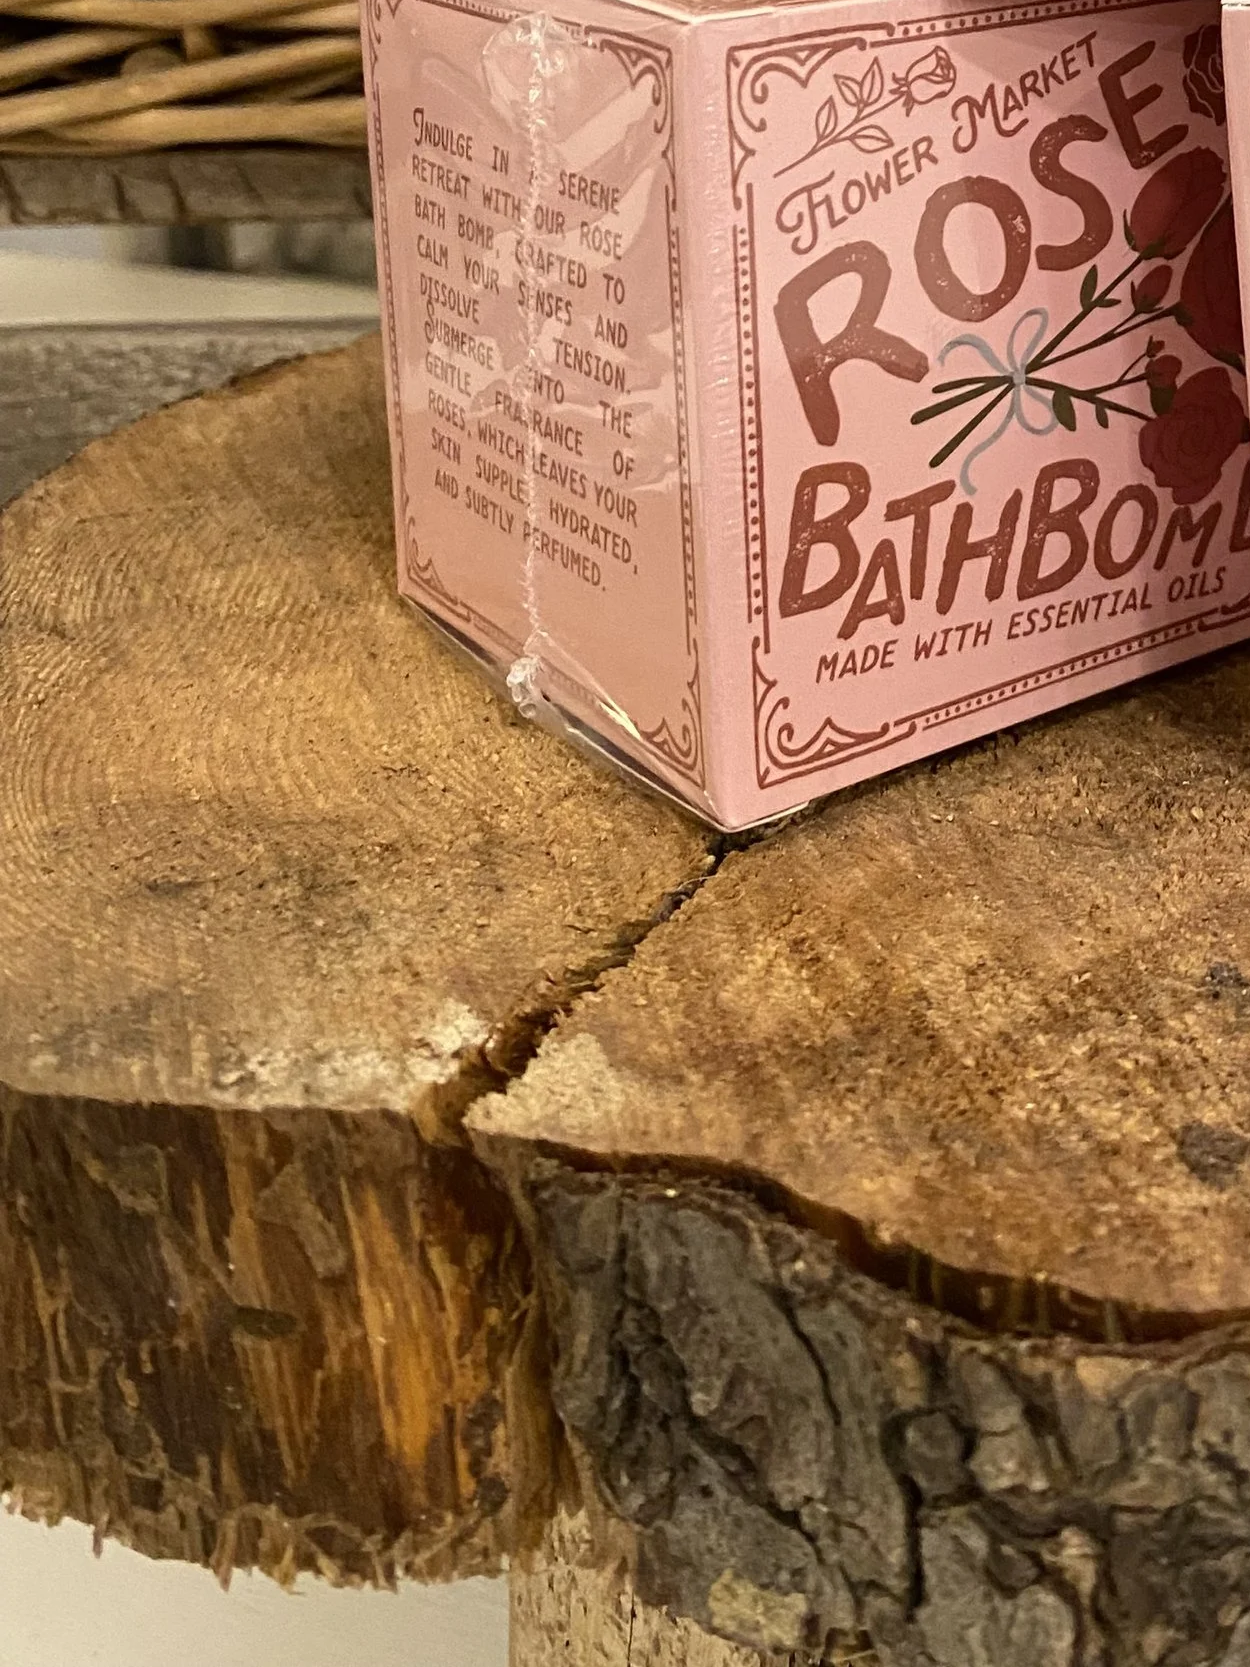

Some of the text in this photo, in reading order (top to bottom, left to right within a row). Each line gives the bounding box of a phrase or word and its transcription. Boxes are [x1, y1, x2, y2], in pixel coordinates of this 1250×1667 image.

[413, 107, 473, 162] INDULGE
[492, 145, 509, 176] IN
[558, 169, 620, 215] SERENE
[776, 30, 1098, 255] FLOWER MARKET
[412, 154, 623, 261] RETREAT WITH OUR ROSE
[415, 194, 625, 305] BATH BOMB, CRAFTED TO
[774, 39, 1190, 447] ROSE
[417, 234, 448, 270] CALM
[463, 255, 500, 295] YOUR
[594, 313, 628, 349] AND
[420, 273, 632, 396] DISSOLVE TENSION.
[424, 299, 633, 439] SUBMERGE NTO THE
[425, 351, 635, 480] GENTLE FRARANCE OF
[428, 388, 638, 528] ROSES, WHICH LEAVES YOUR
[431, 427, 461, 465] SKIN
[549, 498, 638, 575] HYDRATED,
[434, 469, 606, 592] AND SUBTLY PERFUMED.
[816, 566, 1227, 684] MADE WITH ESSENTIAL OILS
